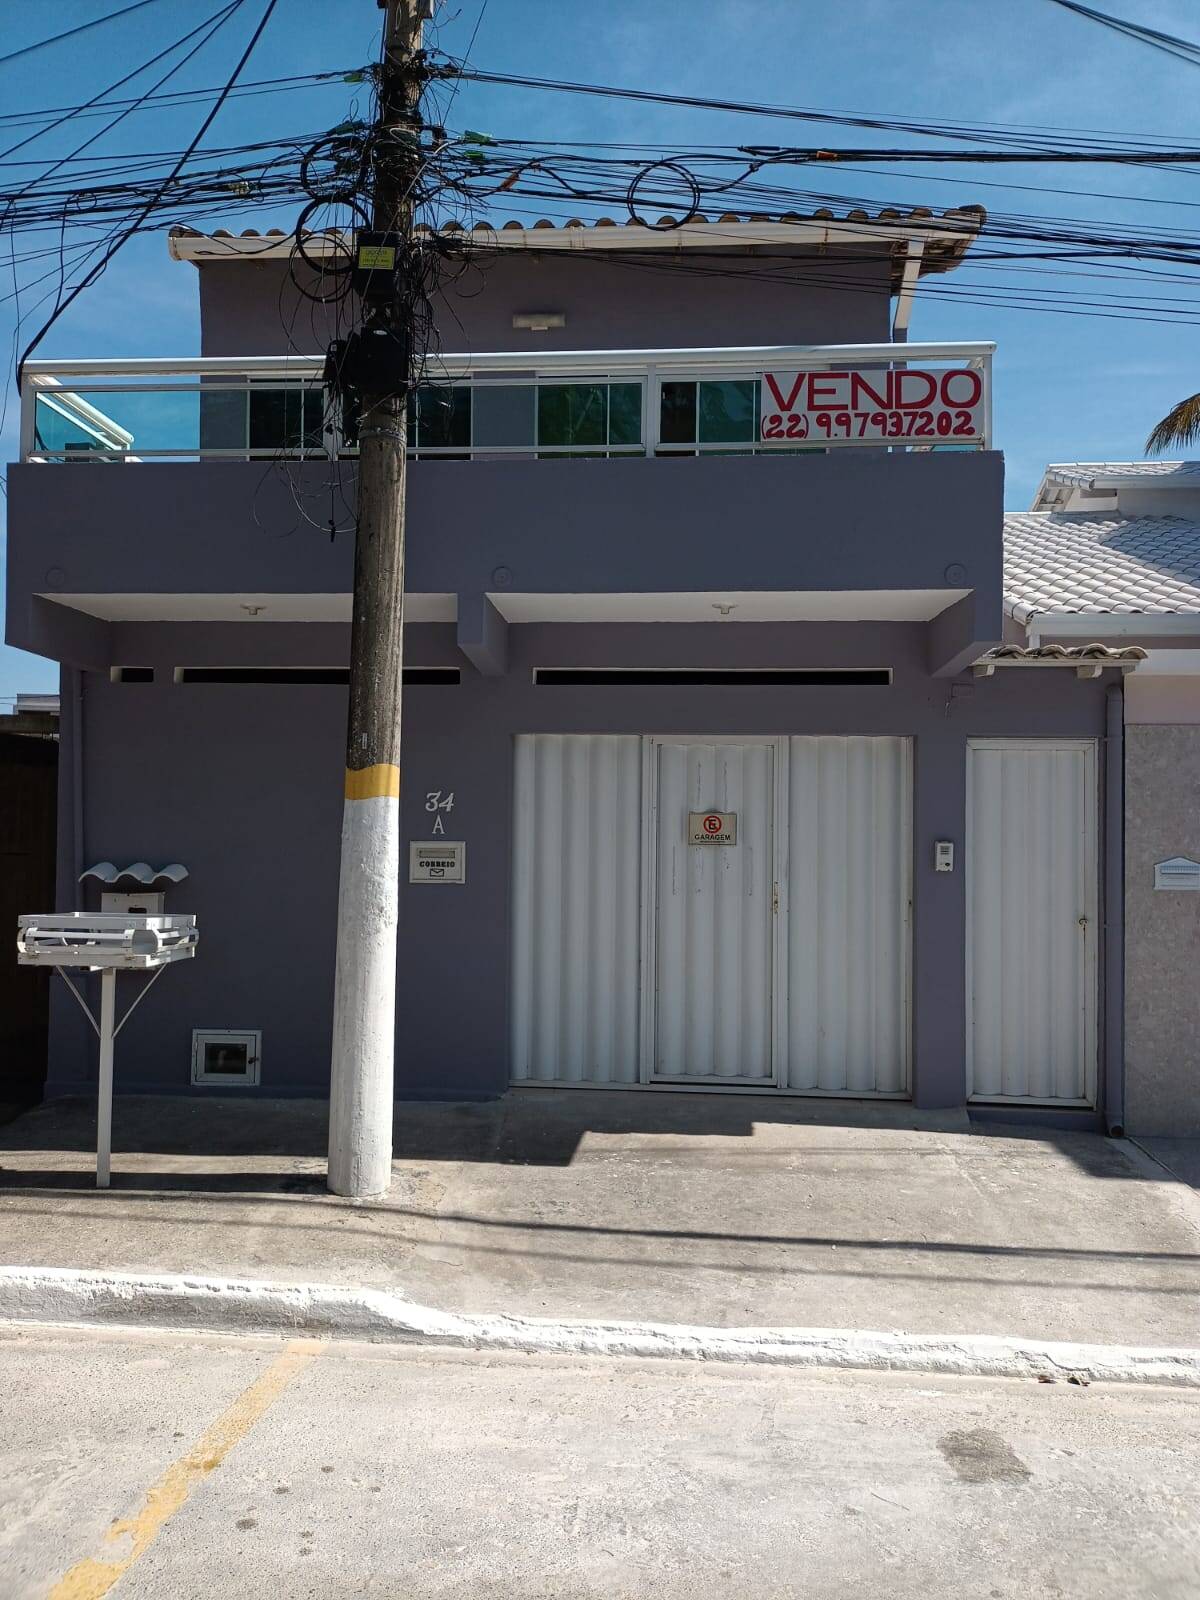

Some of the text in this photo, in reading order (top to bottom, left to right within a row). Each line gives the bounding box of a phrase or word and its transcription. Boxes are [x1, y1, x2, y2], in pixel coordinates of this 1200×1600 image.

[764, 369, 982, 412] VENDO
[761, 413, 810, 440] (22)
[425, 790, 455, 812] 34
[431, 814, 446, 835] A
[694, 833, 731, 841] GARAGEM
[419, 860, 456, 868] CORREIO
